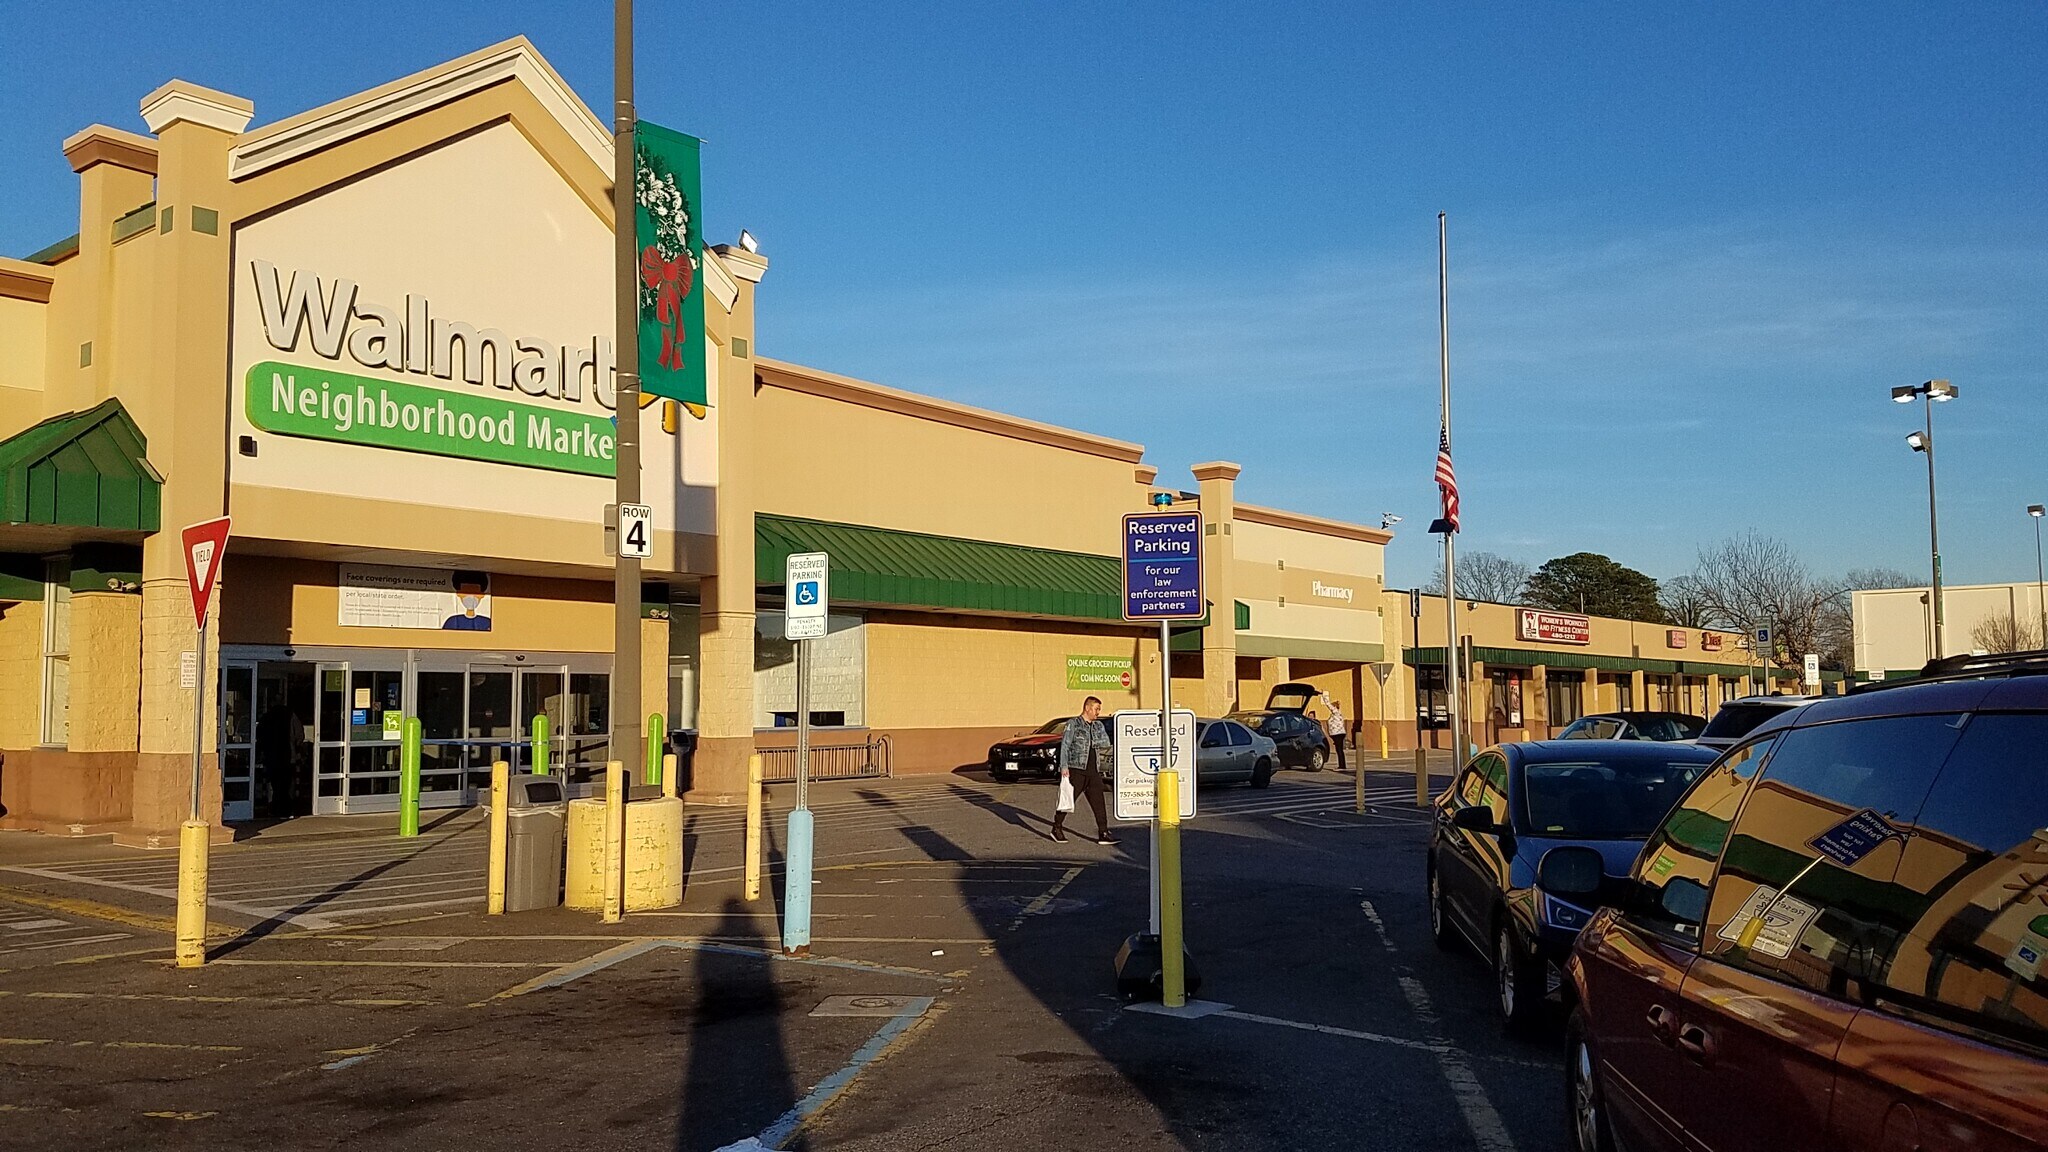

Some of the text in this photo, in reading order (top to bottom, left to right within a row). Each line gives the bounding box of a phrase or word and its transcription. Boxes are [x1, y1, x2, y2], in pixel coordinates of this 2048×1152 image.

[249, 258, 618, 410] Walmart
[270, 372, 617, 462] Neighborhood Marke
[622, 507, 650, 518] ROW
[1128, 519, 1196, 535] Reserved
[626, 520, 647, 552] 4
[1134, 539, 1191, 554] Parking
[195, 548, 211, 563] YIELD
[790, 559, 825, 570] RESERVED
[1145, 565, 1181, 575] for our
[346, 573, 364, 581] Face
[365, 576, 401, 584] coverings
[416, 578, 446, 587] required
[792, 570, 823, 580] PARKING
[1154, 577, 1172, 587] law
[1130, 588, 1197, 600] enforcement
[1312, 580, 1353, 604] Pharmacy
[1142, 602, 1186, 613] partners
[1067, 659, 1132, 669] ONLINE GROCERY PICKUP
[1081, 674, 1103, 683] COMING
[1104, 674, 1121, 683] SOON
[1124, 724, 1186, 737] Resered
